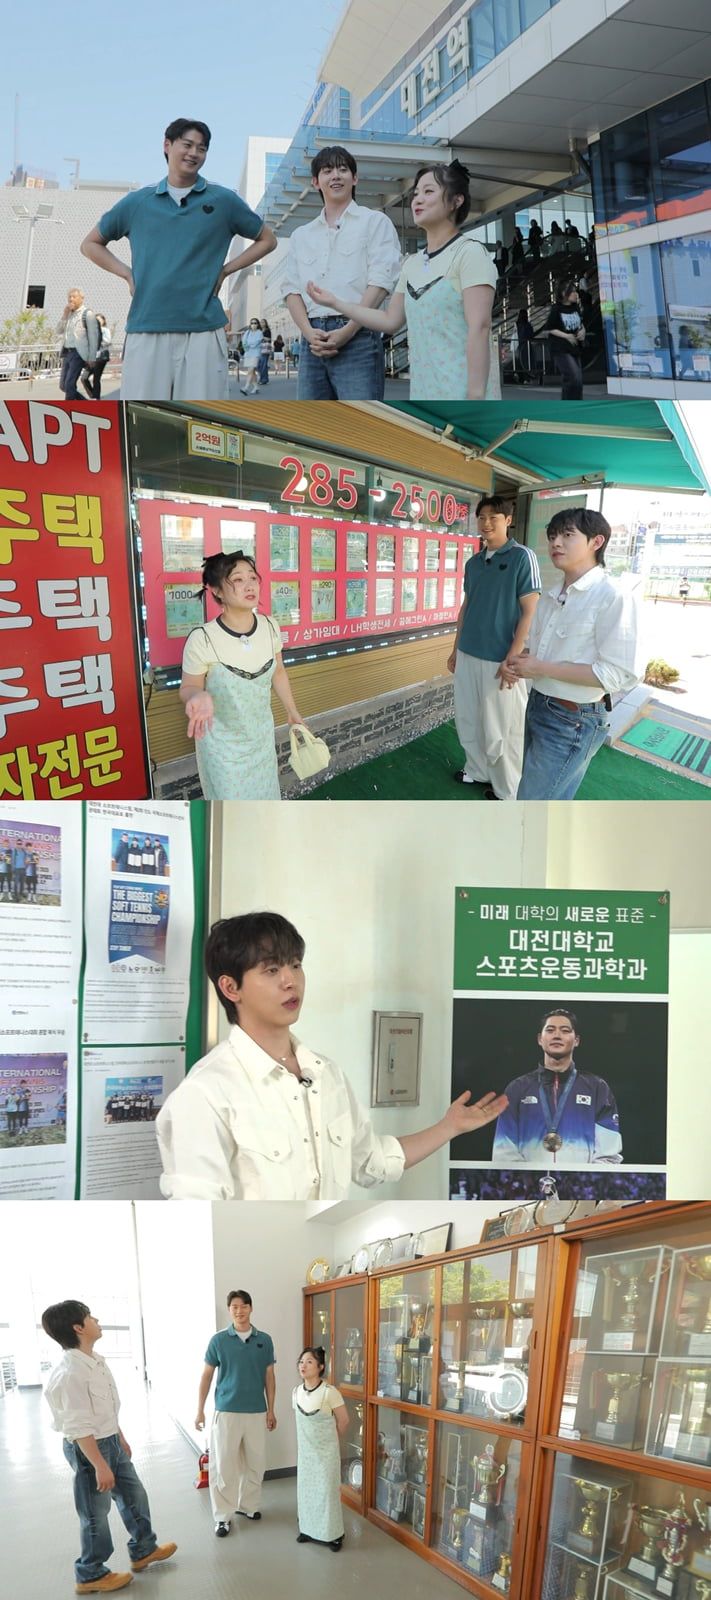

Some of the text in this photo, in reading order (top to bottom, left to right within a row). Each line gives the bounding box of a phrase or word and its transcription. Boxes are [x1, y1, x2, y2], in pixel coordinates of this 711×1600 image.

[400, 16, 470, 118] 대전역
[195, 432, 220, 446] 2억원
[279, 456, 358, 509] 285
[391, 481, 457, 526] 2500
[303, 625, 340, 640] 상가임대
[0, 725, 124, 800] 자전문
[480, 904, 510, 921] 미래
[515, 905, 559, 922] 대학의
[565, 906, 610, 923] 새로운
[615, 907, 645, 924] 표준
[509, 929, 615, 953] 대전대학교
[476, 956, 648, 980] 스포츠운동과학과
